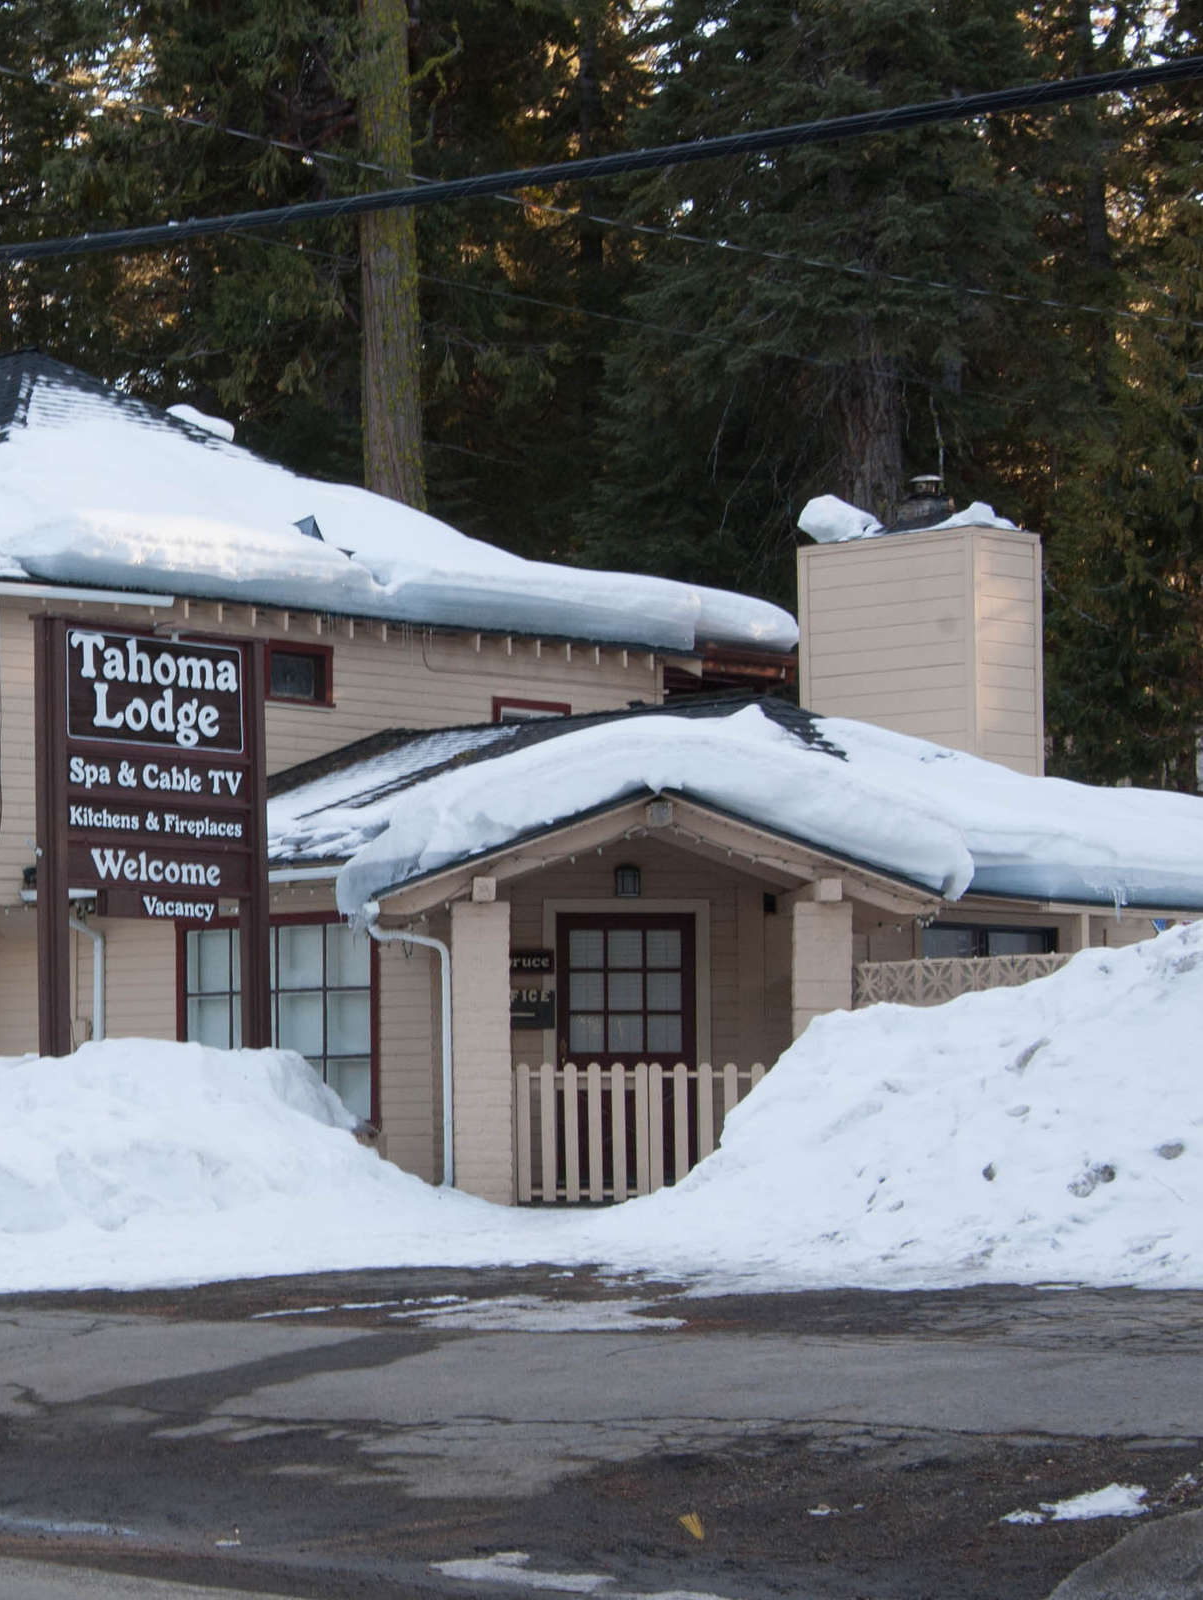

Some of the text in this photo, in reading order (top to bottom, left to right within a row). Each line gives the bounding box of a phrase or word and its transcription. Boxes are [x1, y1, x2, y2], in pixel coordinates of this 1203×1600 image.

[70, 634, 238, 692] Tahoma
[93, 683, 220, 747] Lodge
[69, 757, 243, 796] Spa & Cable TV
[69, 805, 243, 838] Kitchens & Fireplaces
[91, 848, 221, 887] Welcome
[143, 896, 215, 922] Vacancy
[509, 957, 550, 968] ruce
